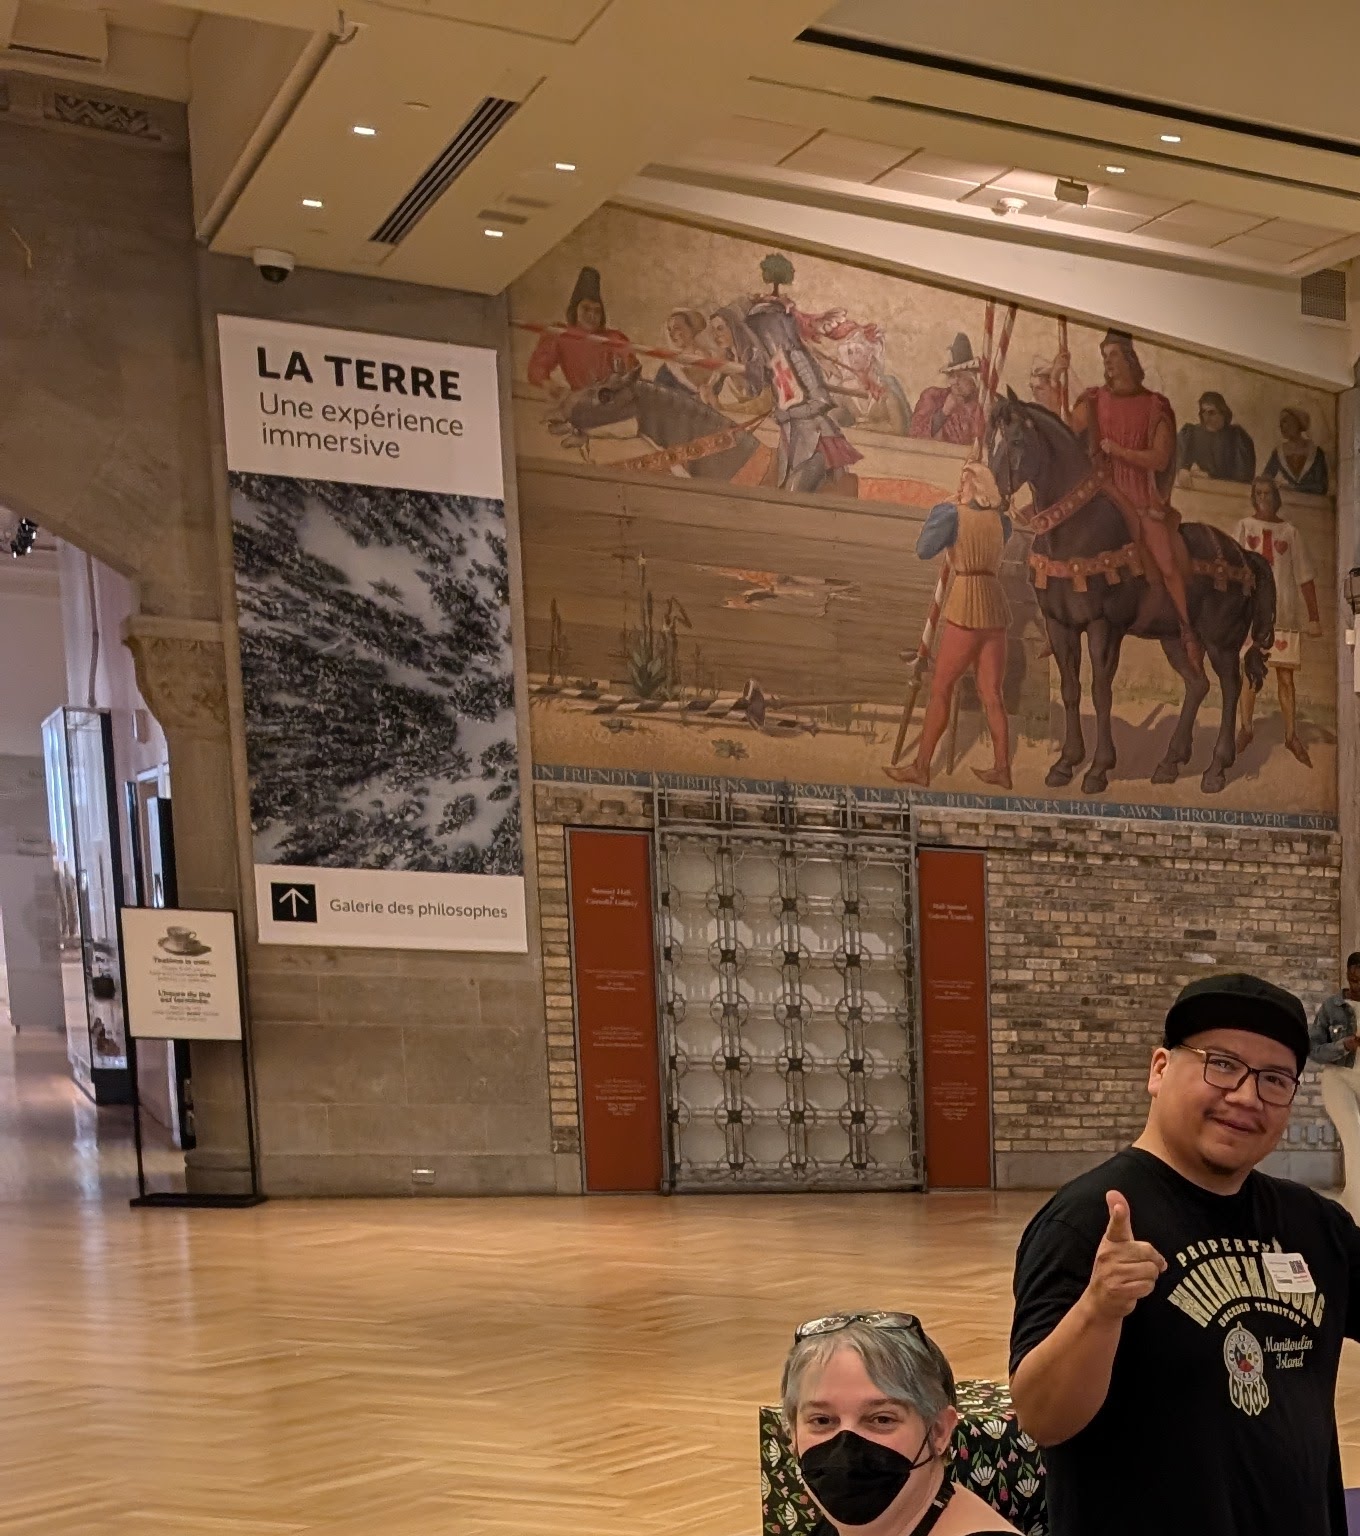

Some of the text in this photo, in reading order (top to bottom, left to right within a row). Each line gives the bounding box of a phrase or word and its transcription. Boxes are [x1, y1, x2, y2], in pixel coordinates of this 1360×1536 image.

[257, 346, 462, 401] LA TERRE
[260, 391, 464, 437] Une expérience
[262, 422, 400, 458] immersive
[534, 764, 554, 779] IN
[562, 766, 638, 786] FRIENDLY
[946, 793, 994, 808] BLUNT
[1005, 797, 1059, 814] LANCES
[1070, 801, 1106, 816] HALF
[1118, 804, 1162, 820] SAWN
[1174, 807, 1244, 824] THROUGH
[1251, 812, 1290, 828] WERE
[1298, 814, 1334, 831] USED
[329, 898, 508, 920] Galerie des philosophes
[1217, 1302, 1307, 1327] UNCEDED TERRITORY
[1264, 1335, 1313, 1352] Manitoulin
[1276, 1352, 1304, 1369] Island
